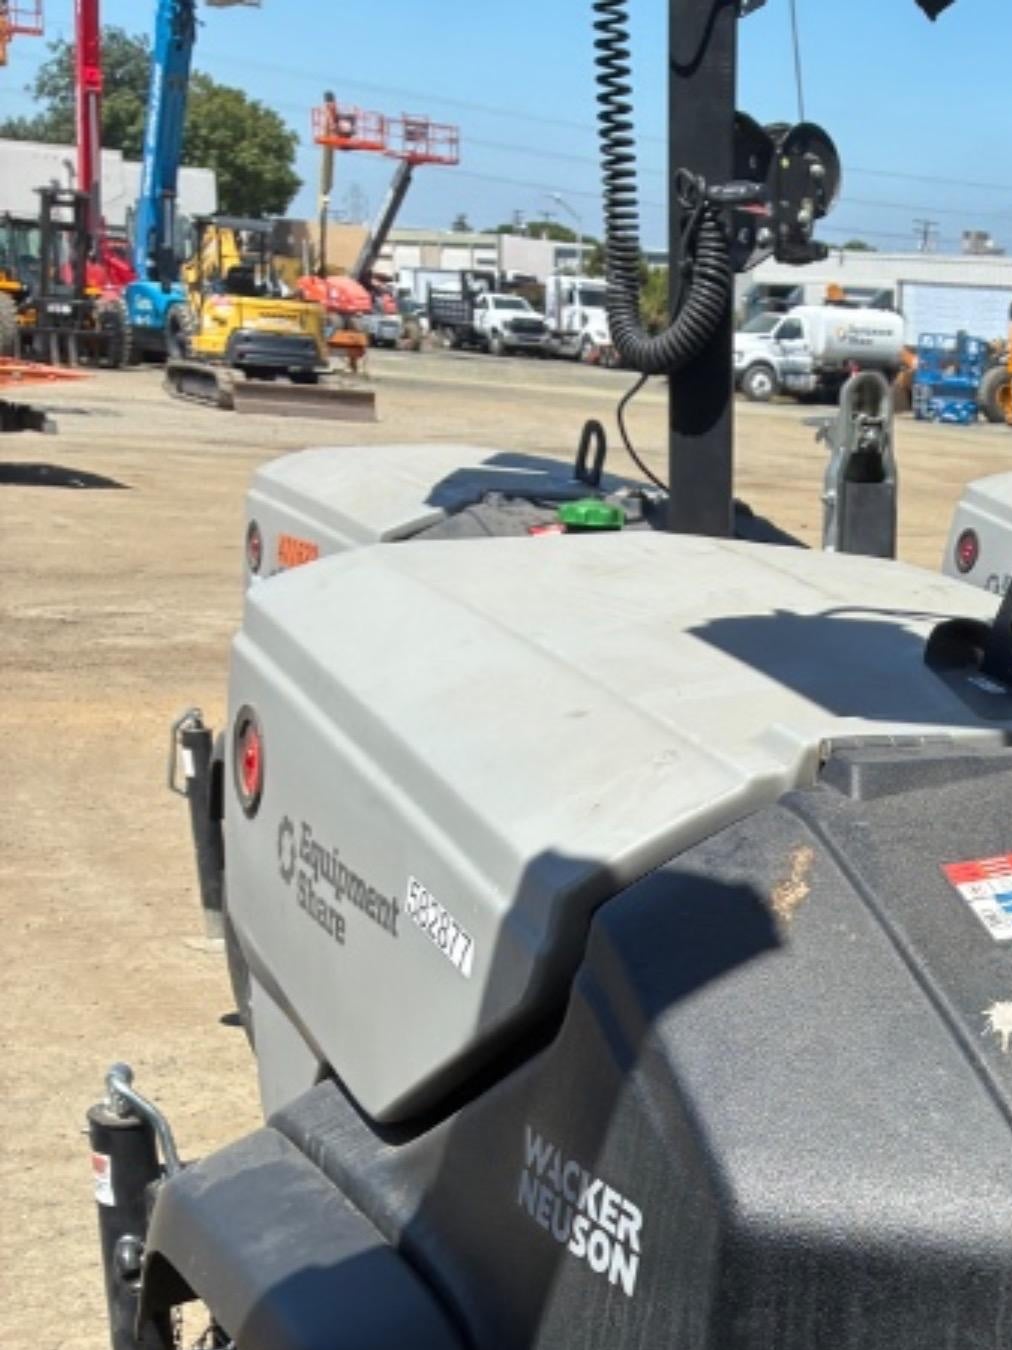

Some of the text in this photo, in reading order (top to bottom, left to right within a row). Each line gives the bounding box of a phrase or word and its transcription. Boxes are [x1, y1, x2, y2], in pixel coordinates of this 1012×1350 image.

[297, 867, 346, 946] Share
[299, 821, 399, 938] Equipment
[518, 1168, 640, 1297] NEUSON
[525, 1124, 643, 1253] WACKER
